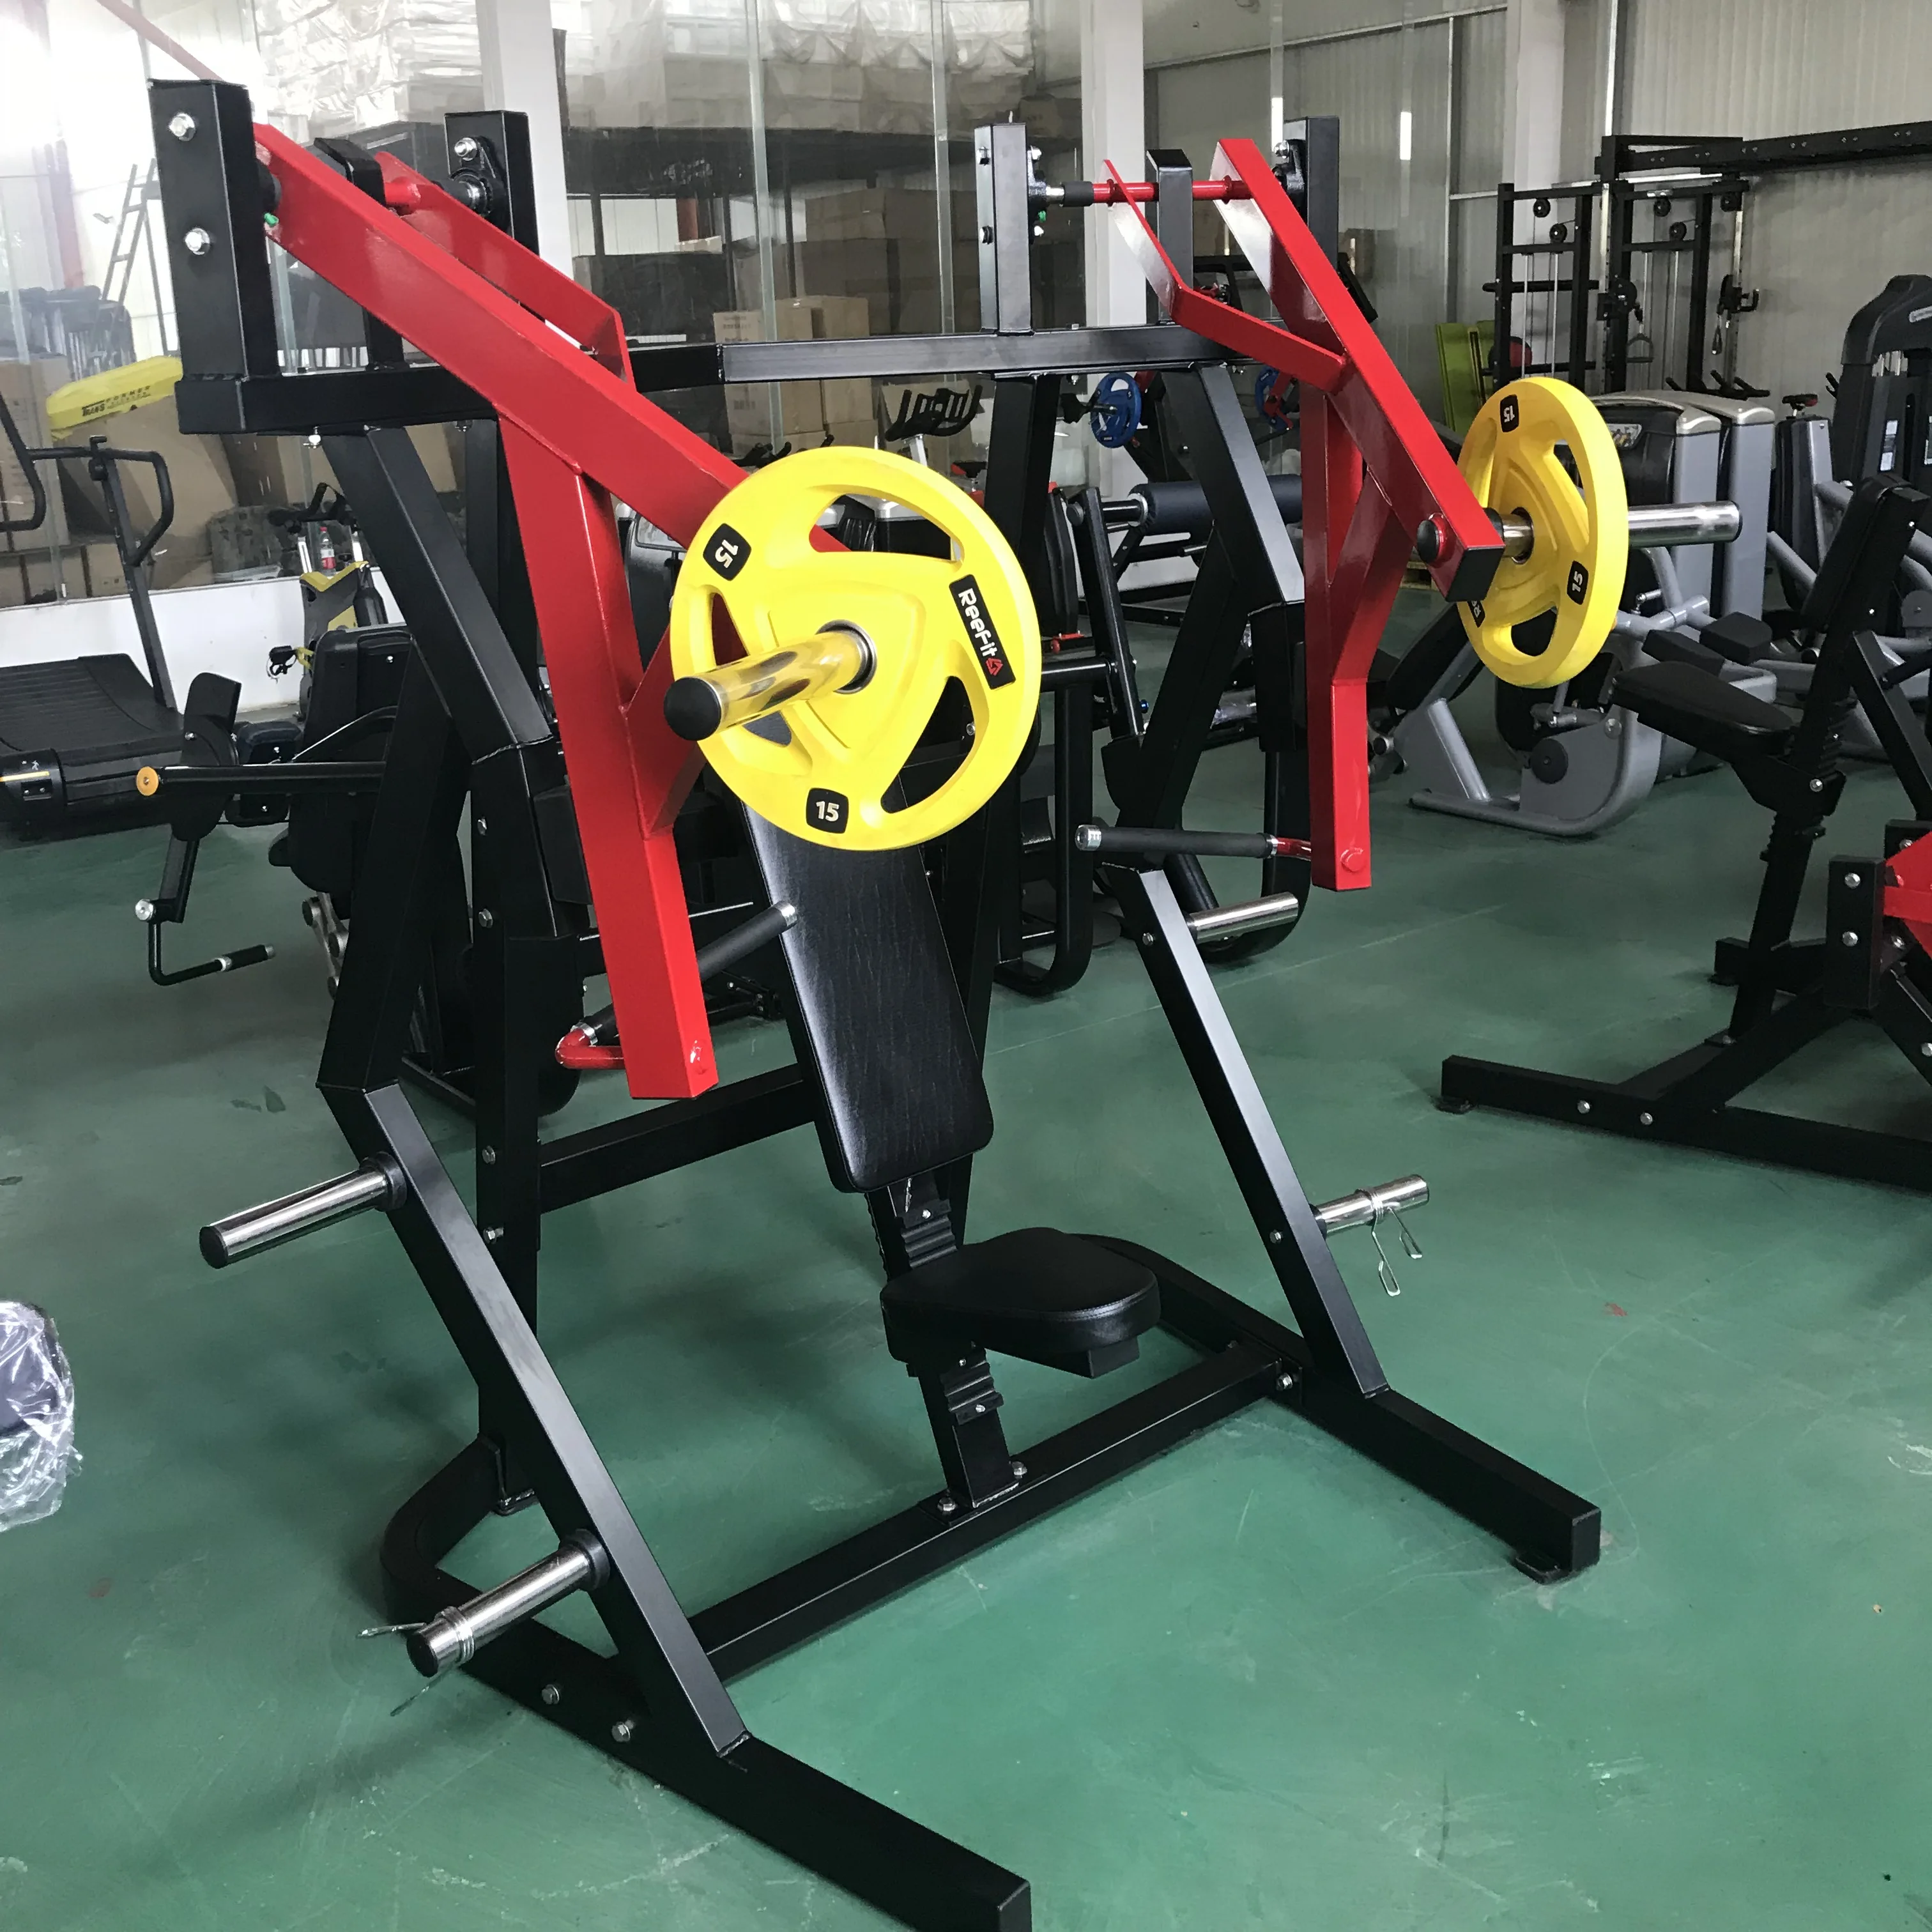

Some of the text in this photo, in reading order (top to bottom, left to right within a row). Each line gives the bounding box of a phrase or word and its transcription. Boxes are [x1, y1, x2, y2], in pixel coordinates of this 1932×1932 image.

[1503, 405, 1515, 423] 15
[714, 539, 739, 569] 15
[1572, 571, 1583, 592] 15
[958, 587, 998, 657] Reefit
[816, 801, 839, 822] 15
